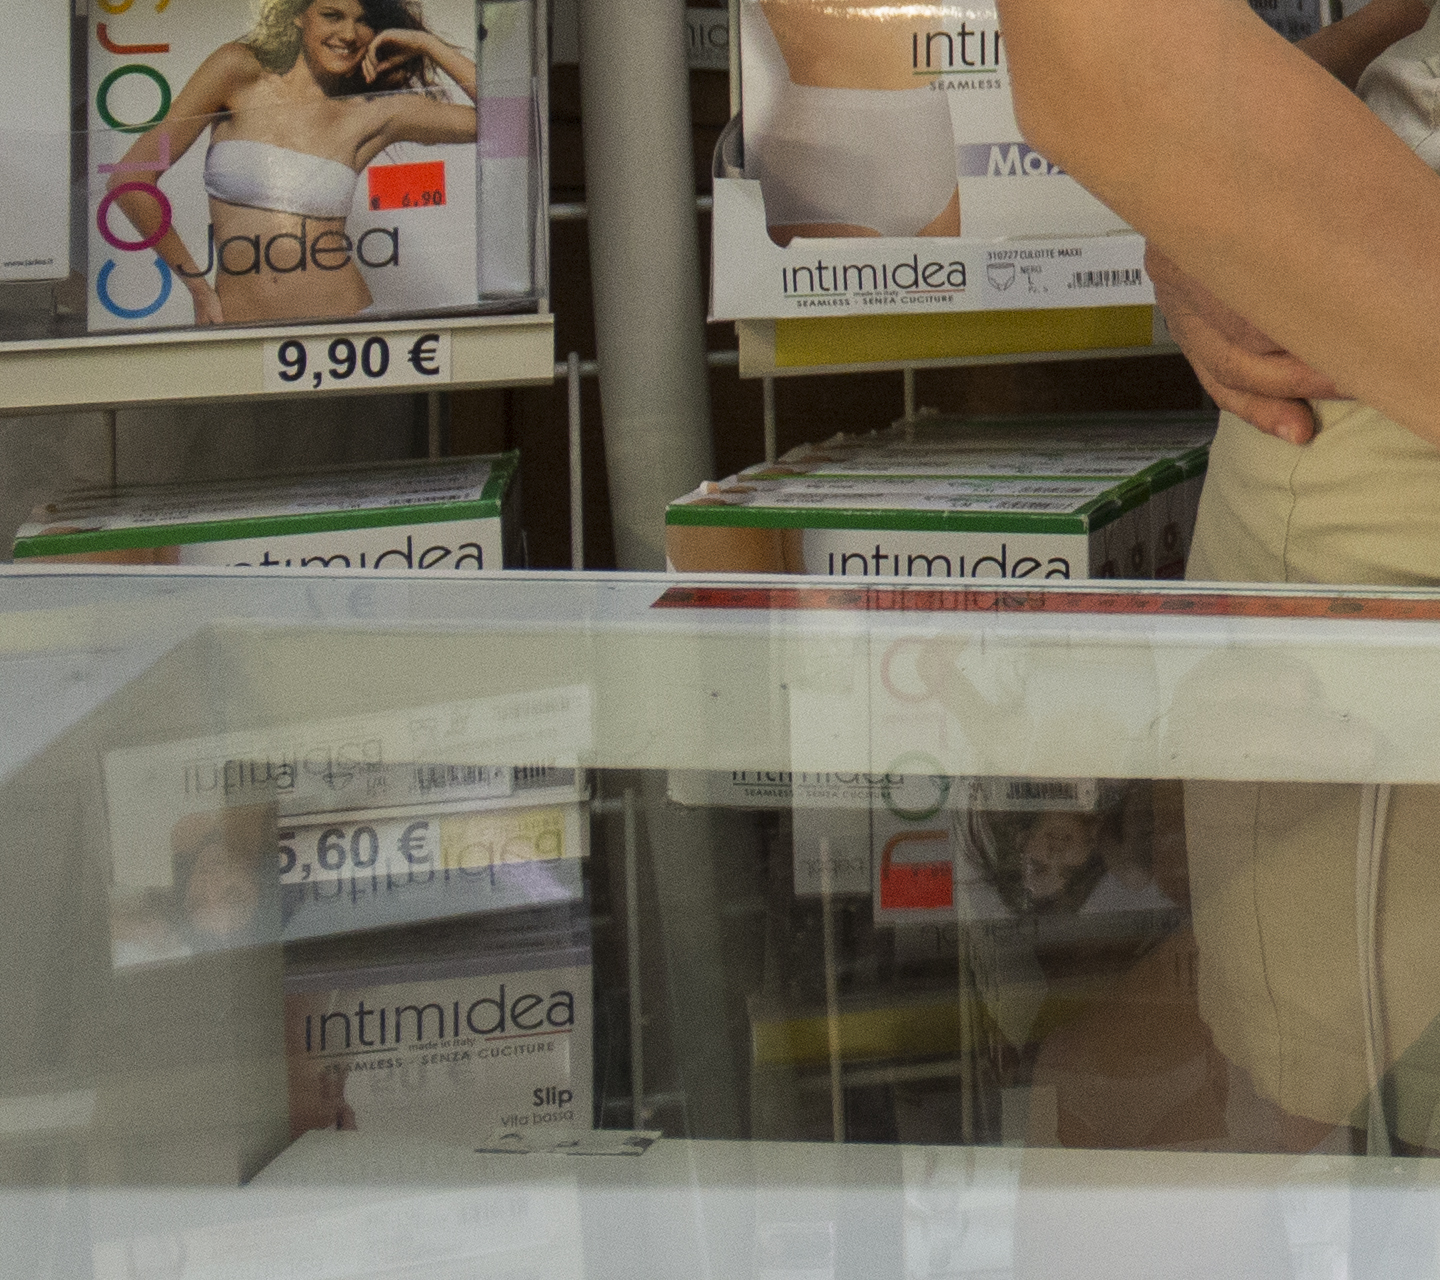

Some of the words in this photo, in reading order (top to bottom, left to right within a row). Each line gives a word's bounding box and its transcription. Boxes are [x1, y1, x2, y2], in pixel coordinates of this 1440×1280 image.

[929, 78, 1002, 92] SEAMLESS
[176, 222, 401, 278] Jadea
[783, 254, 967, 293] intimidea
[277, 337, 391, 388] 9,90
[407, 334, 440, 376] €
[828, 543, 1072, 581] intimidea
[396, 822, 431, 863] €
[304, 982, 576, 1053] intimidea
[477, 1041, 556, 1060] CUCITURE
[532, 1085, 574, 1108] Slip
